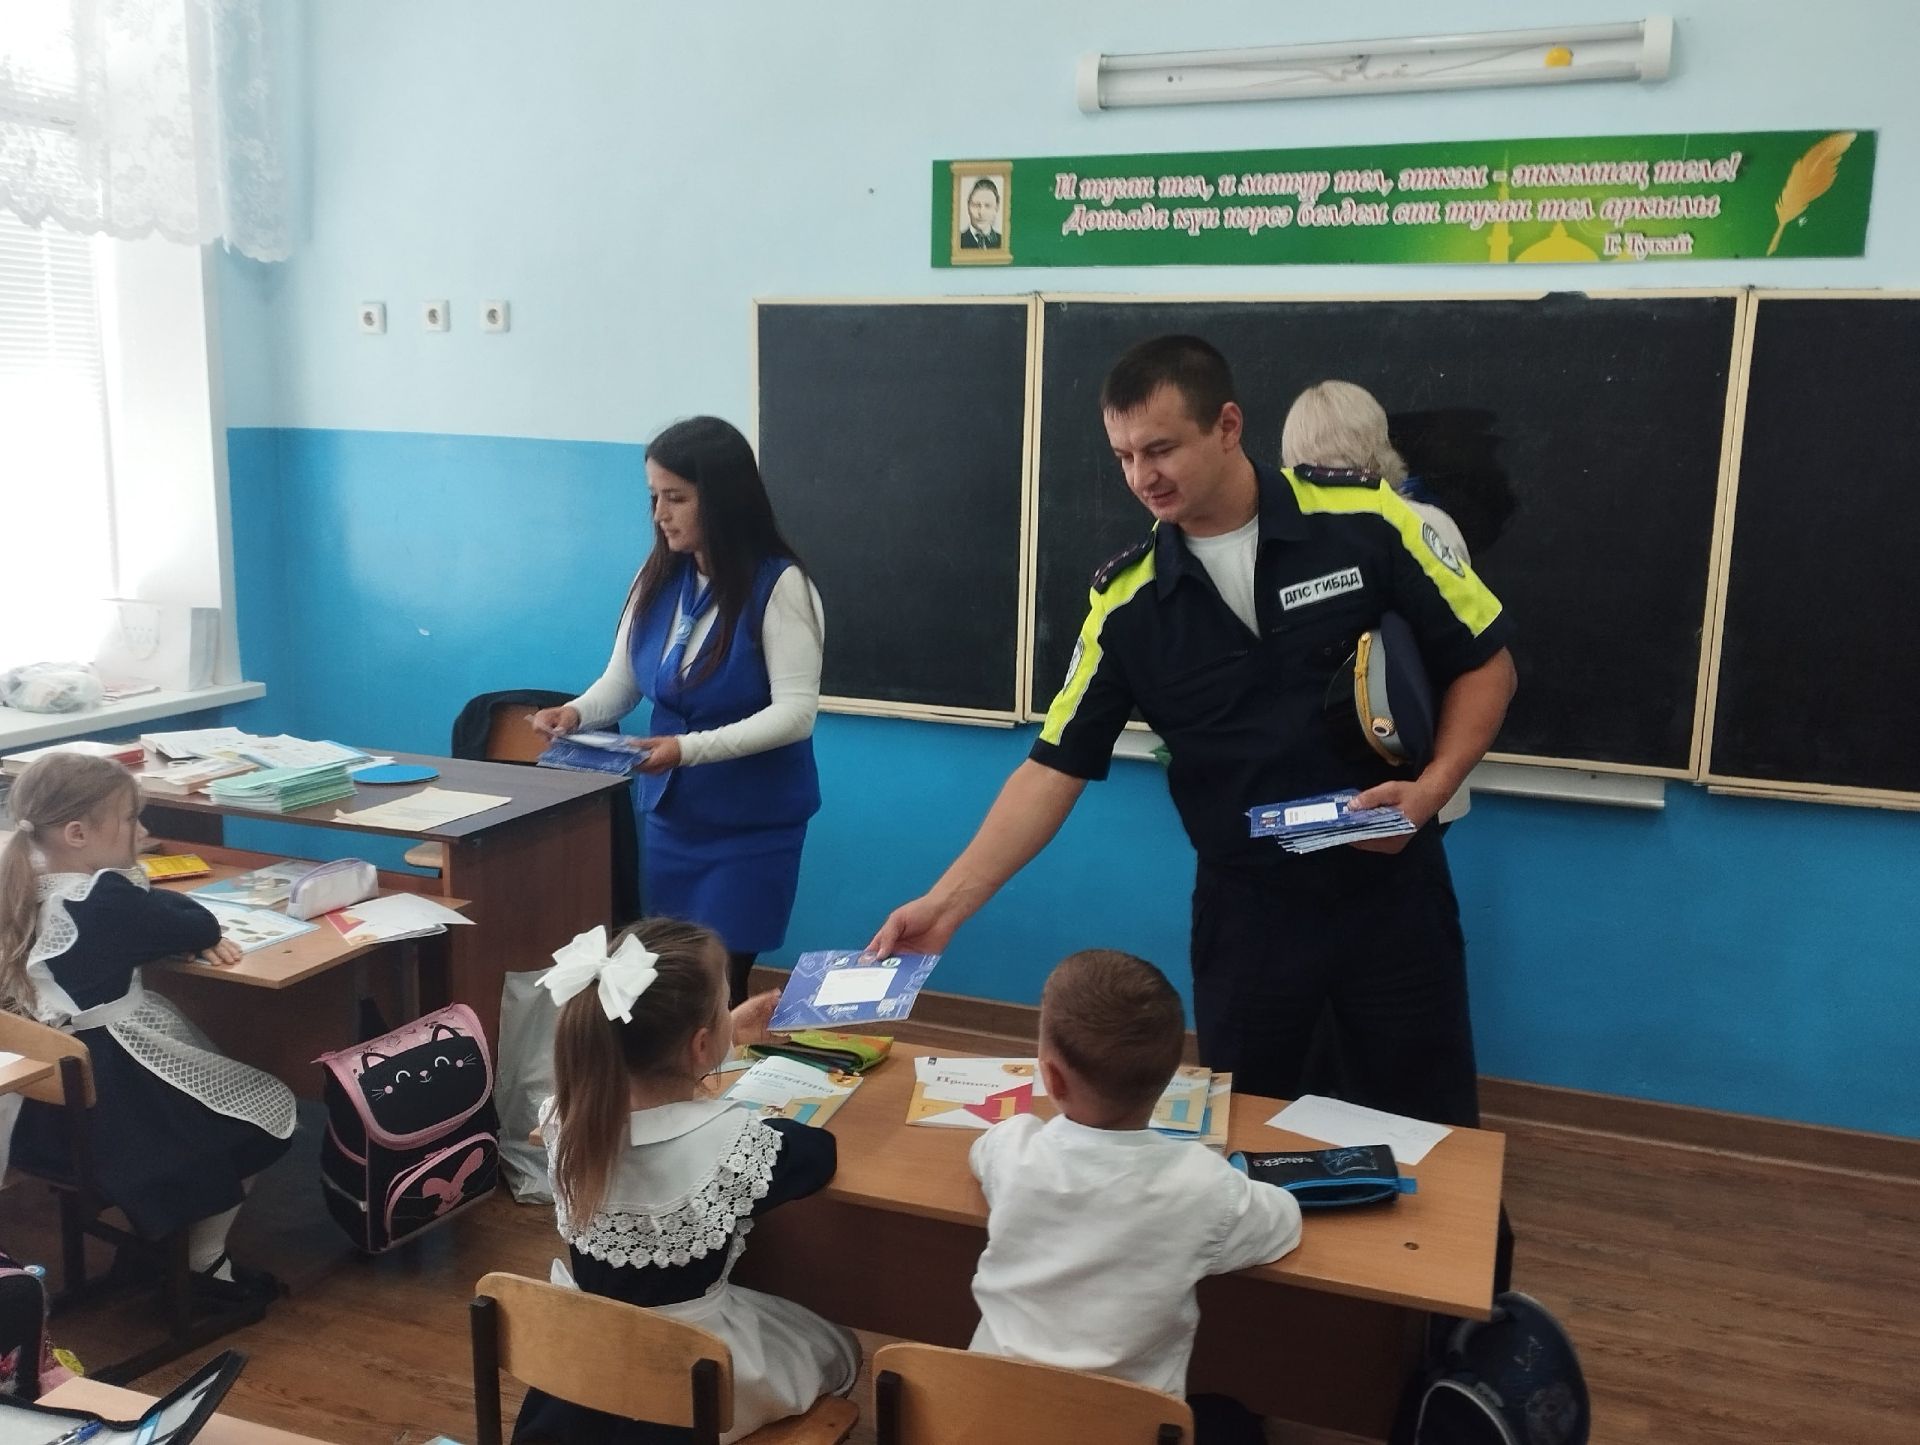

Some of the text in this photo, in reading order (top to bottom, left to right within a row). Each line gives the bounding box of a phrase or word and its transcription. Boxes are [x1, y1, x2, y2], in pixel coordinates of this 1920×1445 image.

[1055, 172, 1077, 200] И
[1079, 175, 1156, 206] туган
[1158, 175, 1214, 201] тел,
[1218, 173, 1236, 197] и
[1238, 170, 1330, 202] матур
[1333, 168, 1394, 197] тел,
[1653, 151, 1742, 184] теле!
[1297, 197, 1390, 227] белдем
[1393, 201, 1441, 225] син
[1444, 199, 1533, 231] туган
[1537, 197, 1595, 222] тел
[1600, 194, 1721, 228] аркылы
[1624, 232, 1694, 261] Тукай
[1284, 571, 1360, 606] ДПС ГИБДД
